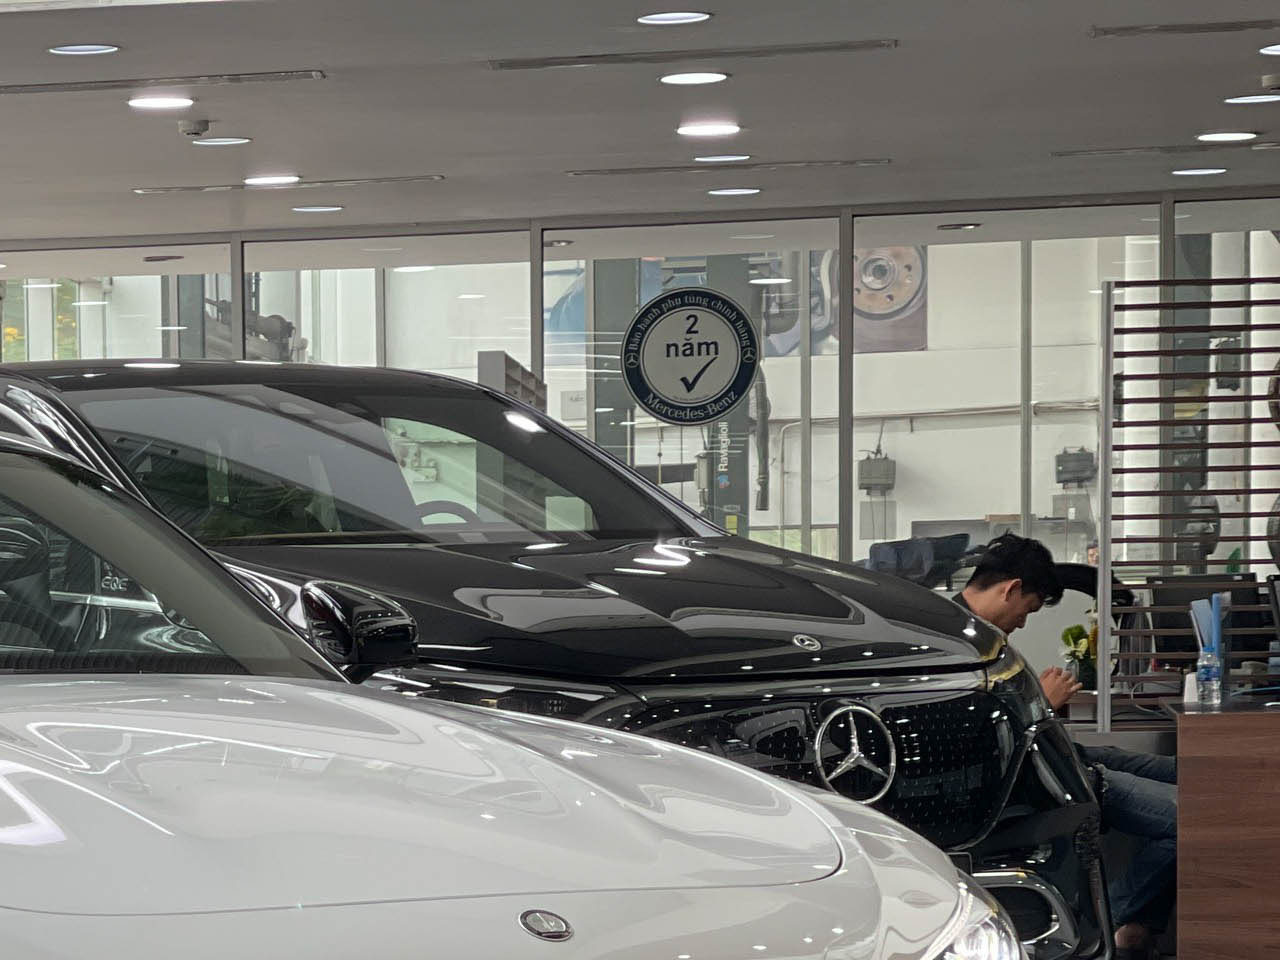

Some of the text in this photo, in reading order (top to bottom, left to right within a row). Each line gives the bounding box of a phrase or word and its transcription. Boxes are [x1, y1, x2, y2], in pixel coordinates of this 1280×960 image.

[684, 313, 699, 335] 2
[666, 337, 719, 358] năm
[643, 389, 738, 420] Mercedes-Benz
[101, 576, 129, 591] EQE
